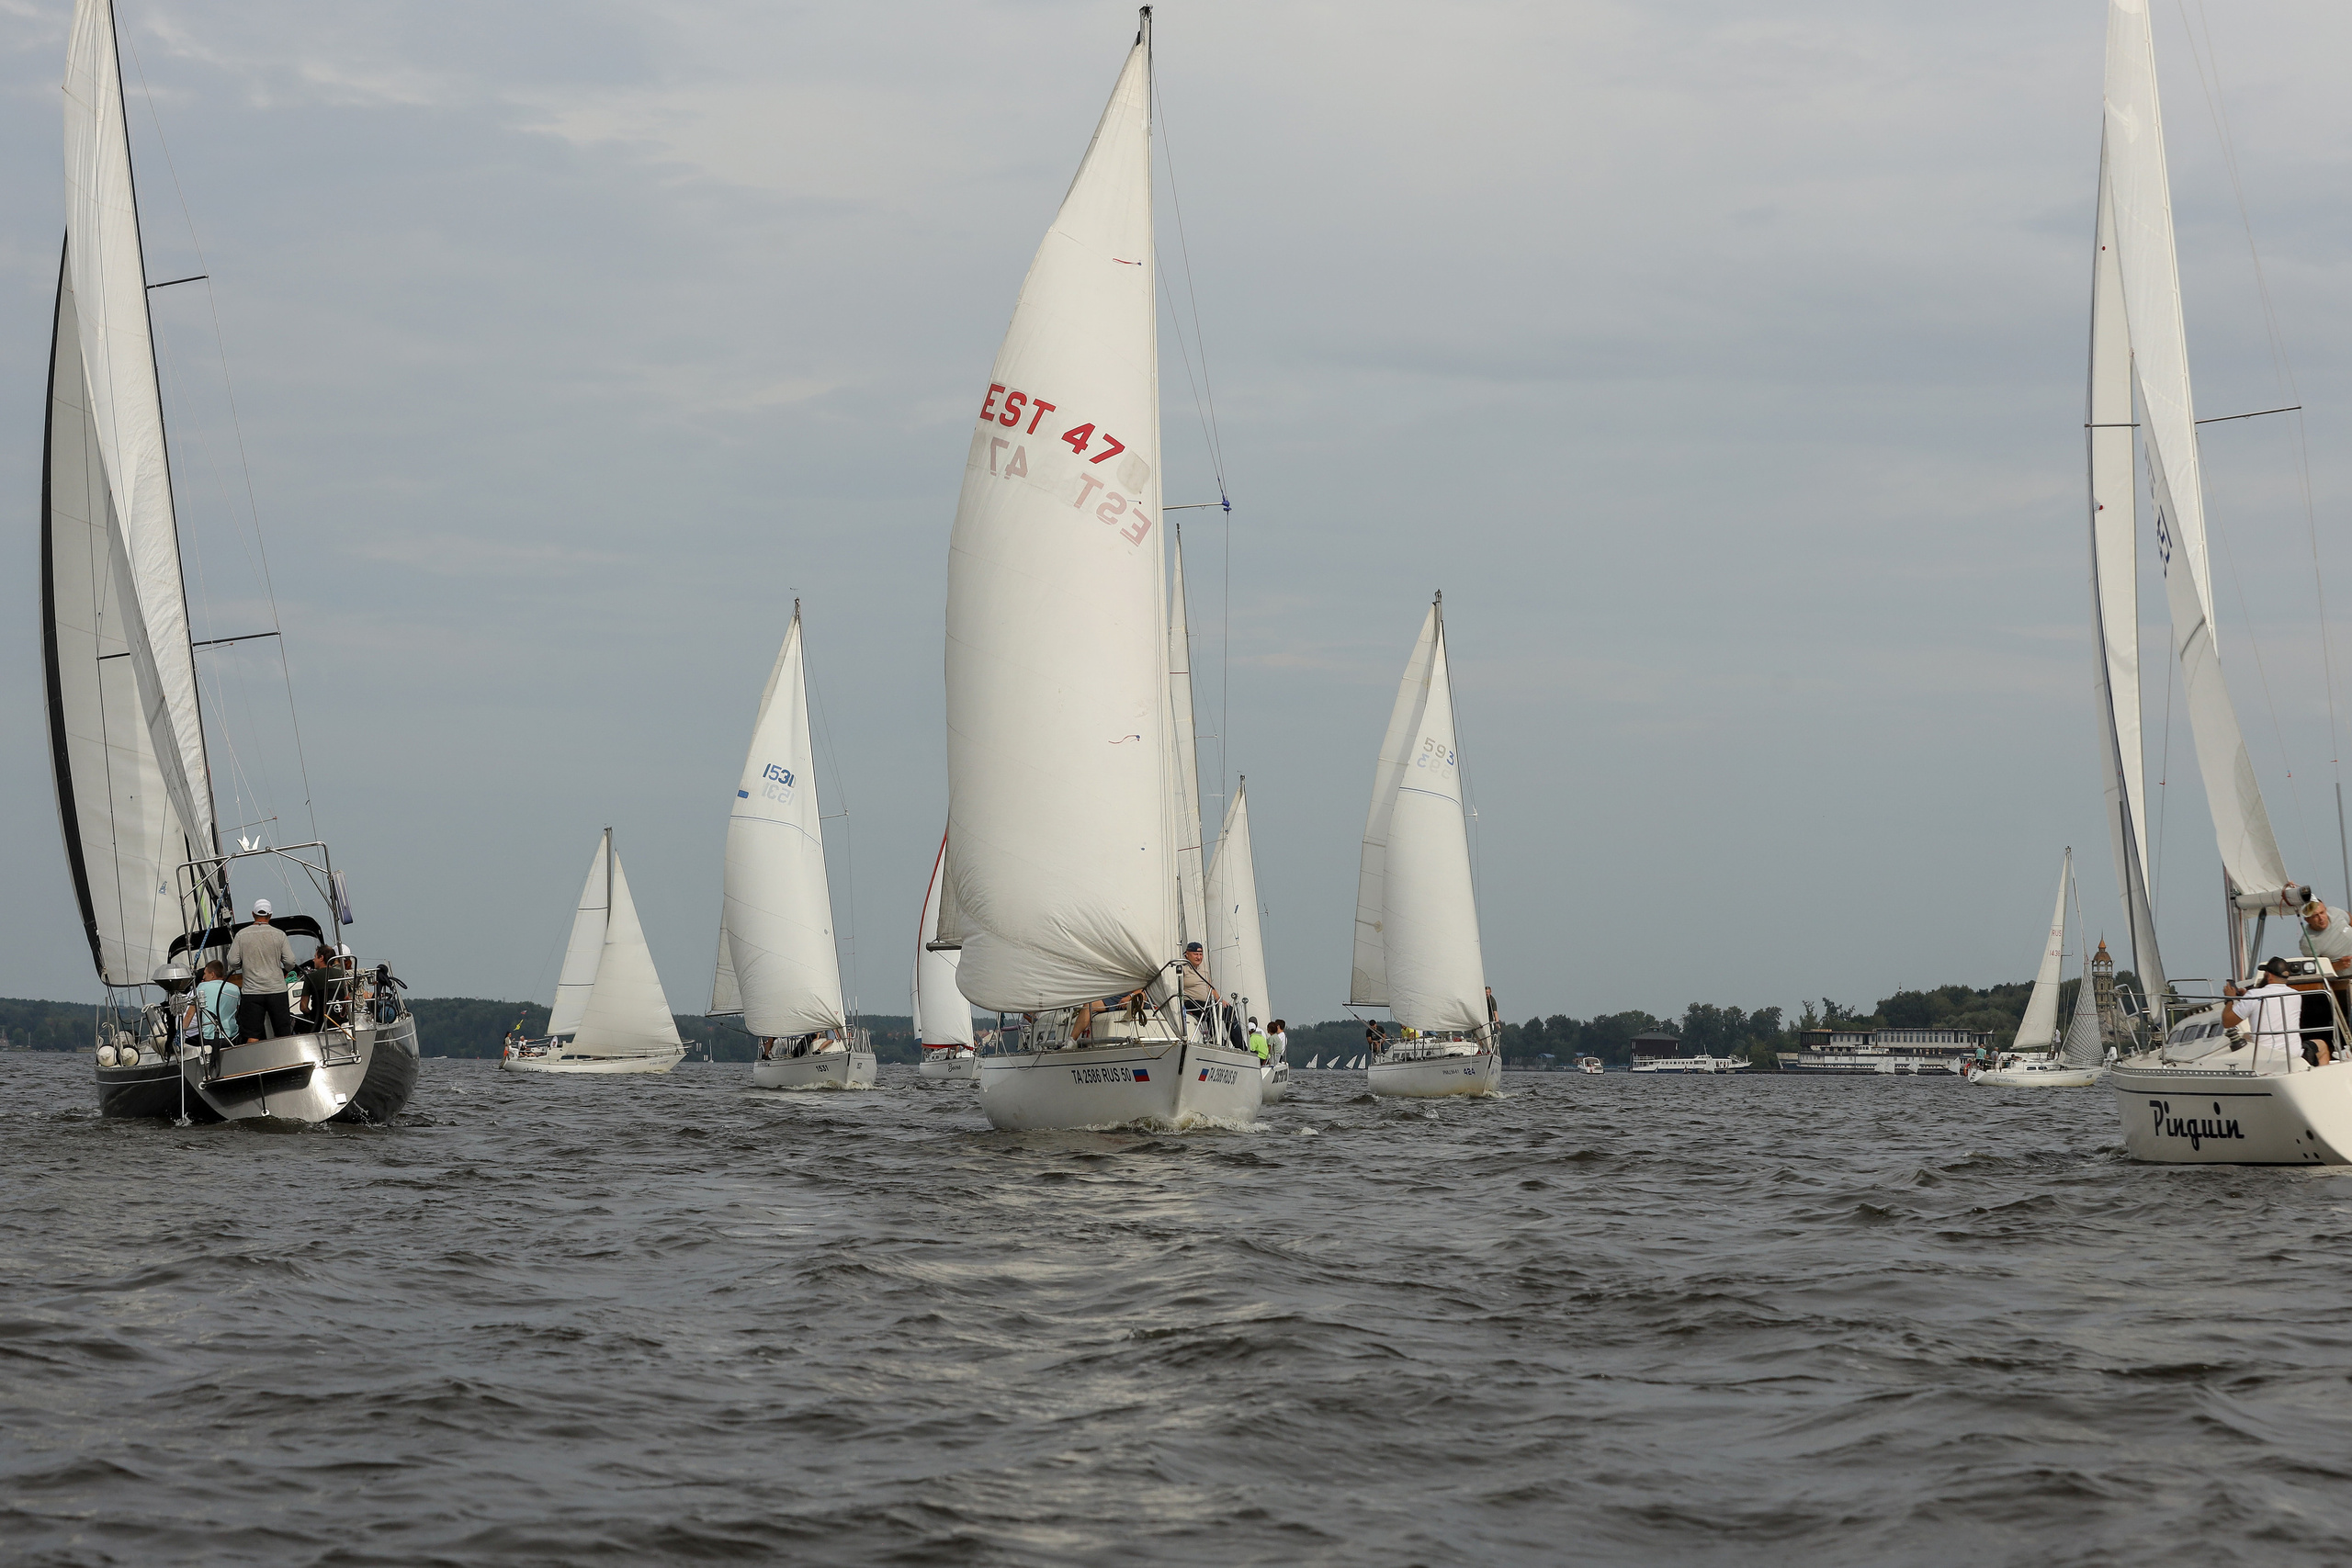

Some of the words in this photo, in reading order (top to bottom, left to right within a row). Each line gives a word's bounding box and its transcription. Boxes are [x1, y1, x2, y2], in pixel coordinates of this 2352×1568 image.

[979, 383, 1057, 435] EST
[1061, 422, 1125, 465] 47
[763, 762, 796, 787] 1531
[815, 1065, 830, 1073] 1531
[1071, 1069, 1083, 1084] TA
[1083, 1068, 1102, 1084] 2586
[1102, 1067, 1120, 1083] RUS
[1121, 1067, 1131, 1082] 50
[2149, 1100, 2245, 1152] Pinguin
